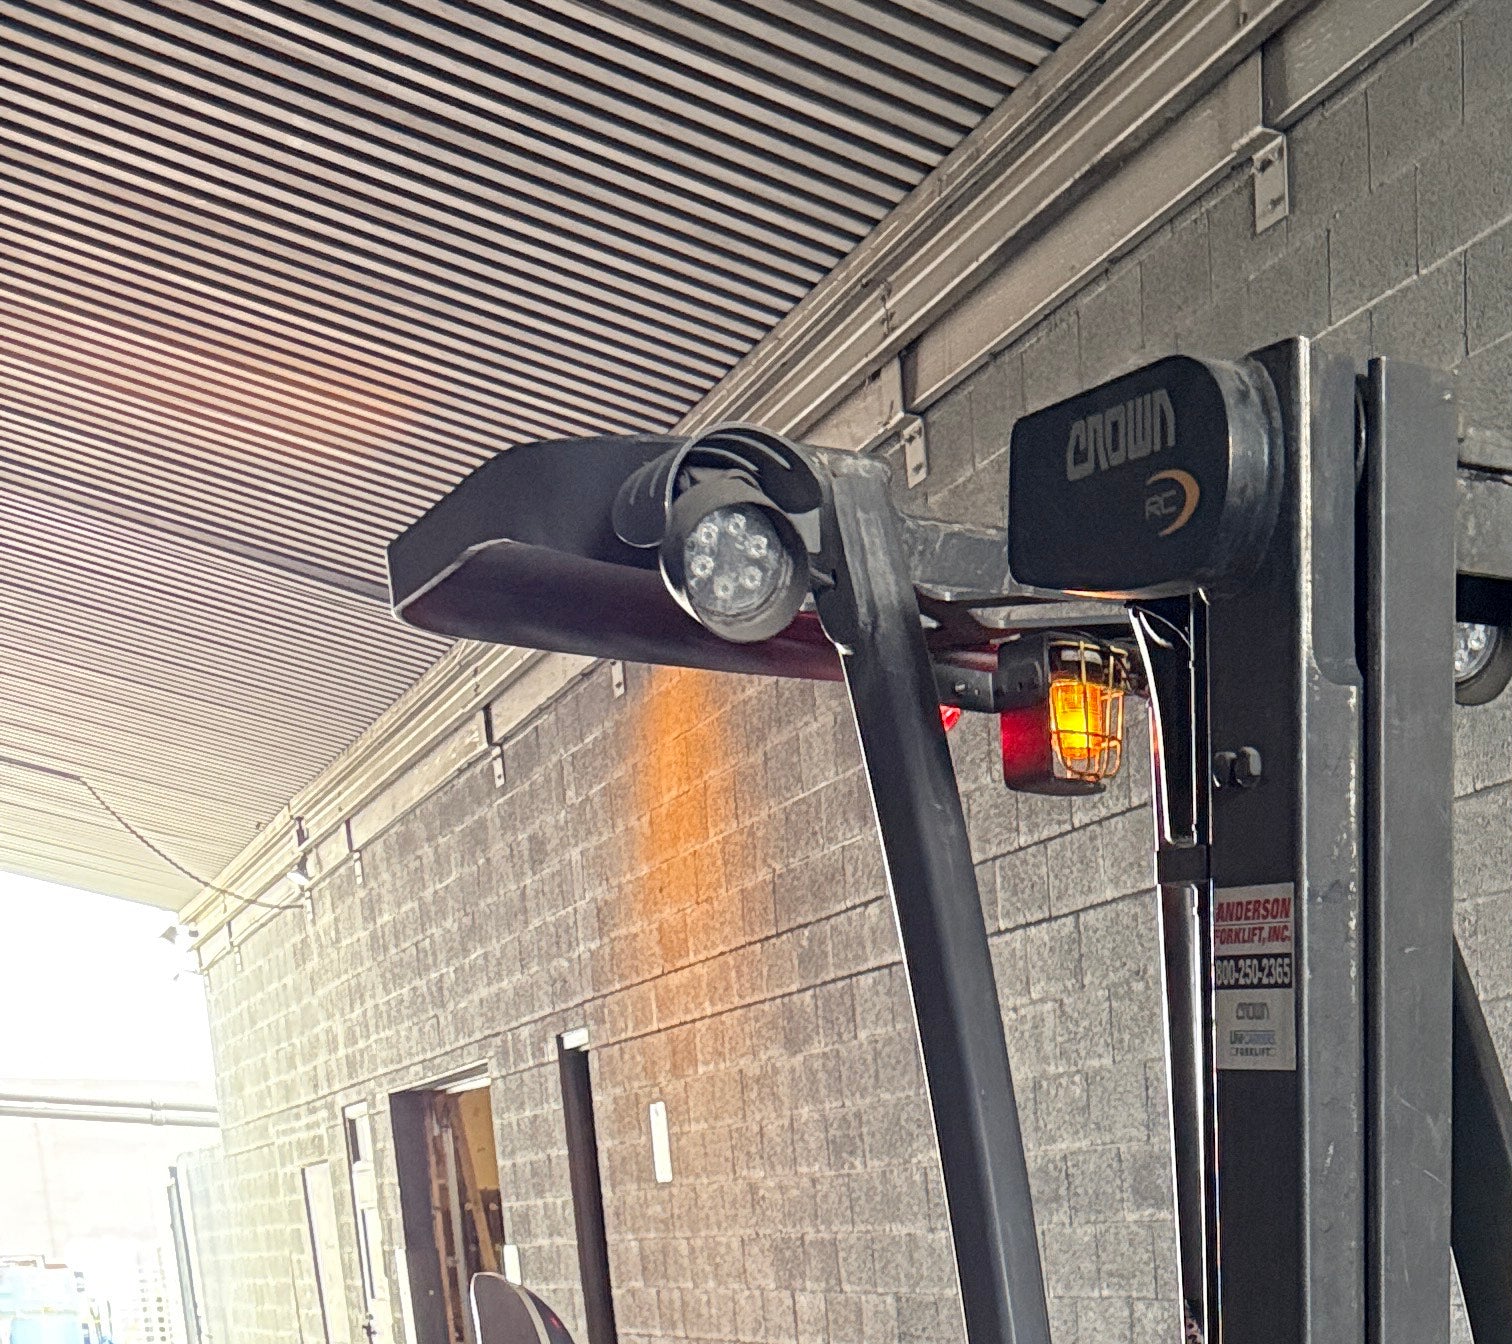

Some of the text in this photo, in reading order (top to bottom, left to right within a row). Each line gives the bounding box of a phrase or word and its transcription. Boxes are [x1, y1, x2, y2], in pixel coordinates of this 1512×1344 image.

[1145, 490, 1177, 520] RC
[1215, 897, 1292, 922] ANDERSON
[1214, 924, 1291, 946] FORKLIFT, INC.
[1215, 957, 1291, 986] 800-250-2365
